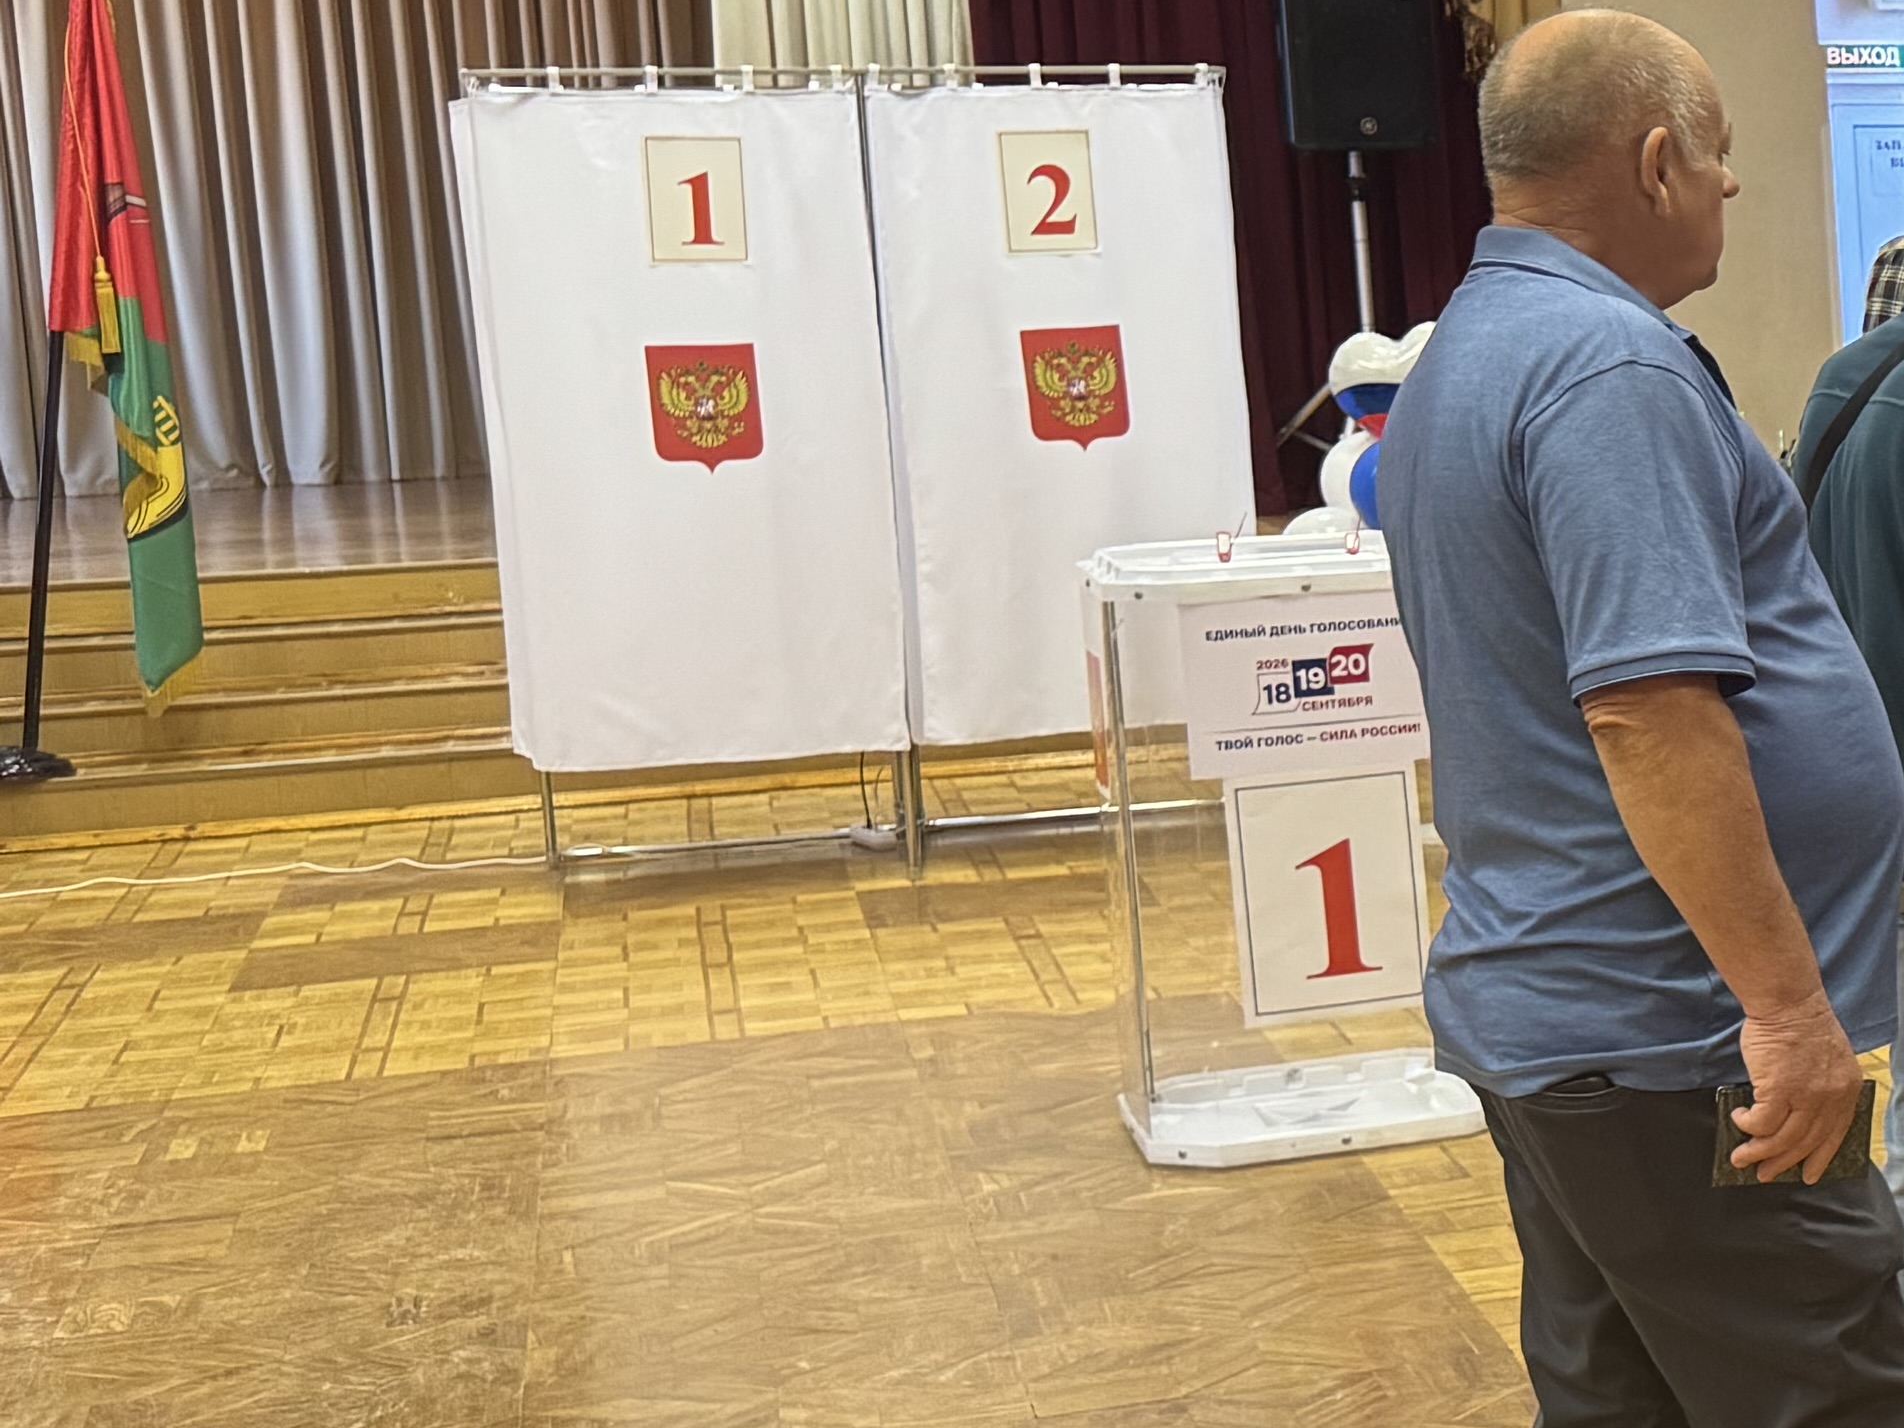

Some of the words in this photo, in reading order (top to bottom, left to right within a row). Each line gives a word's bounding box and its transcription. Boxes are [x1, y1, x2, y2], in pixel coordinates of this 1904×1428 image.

[1826, 46, 1901, 67] ВЫХОД
[677, 170, 725, 246] 1
[1026, 163, 1078, 236] 2
[1205, 625, 1266, 642] ЕДИНЫЙ
[1269, 622, 1307, 638] ДЕНЬ
[1310, 617, 1401, 634] ГОЛОСОВАНИ
[1256, 658, 1290, 671] 2026
[1262, 682, 1292, 705] 18
[1296, 667, 1326, 691] 19
[1330, 653, 1367, 677] 20
[1302, 695, 1374, 712] СЕНТЯБРЯ
[1215, 735, 1254, 752] ТВОЙ
[1257, 733, 1304, 749] ГОЛОС
[1319, 726, 1358, 742] СИЛА
[1361, 722, 1421, 739] РОССИИ!
[1294, 838, 1383, 981] 1
